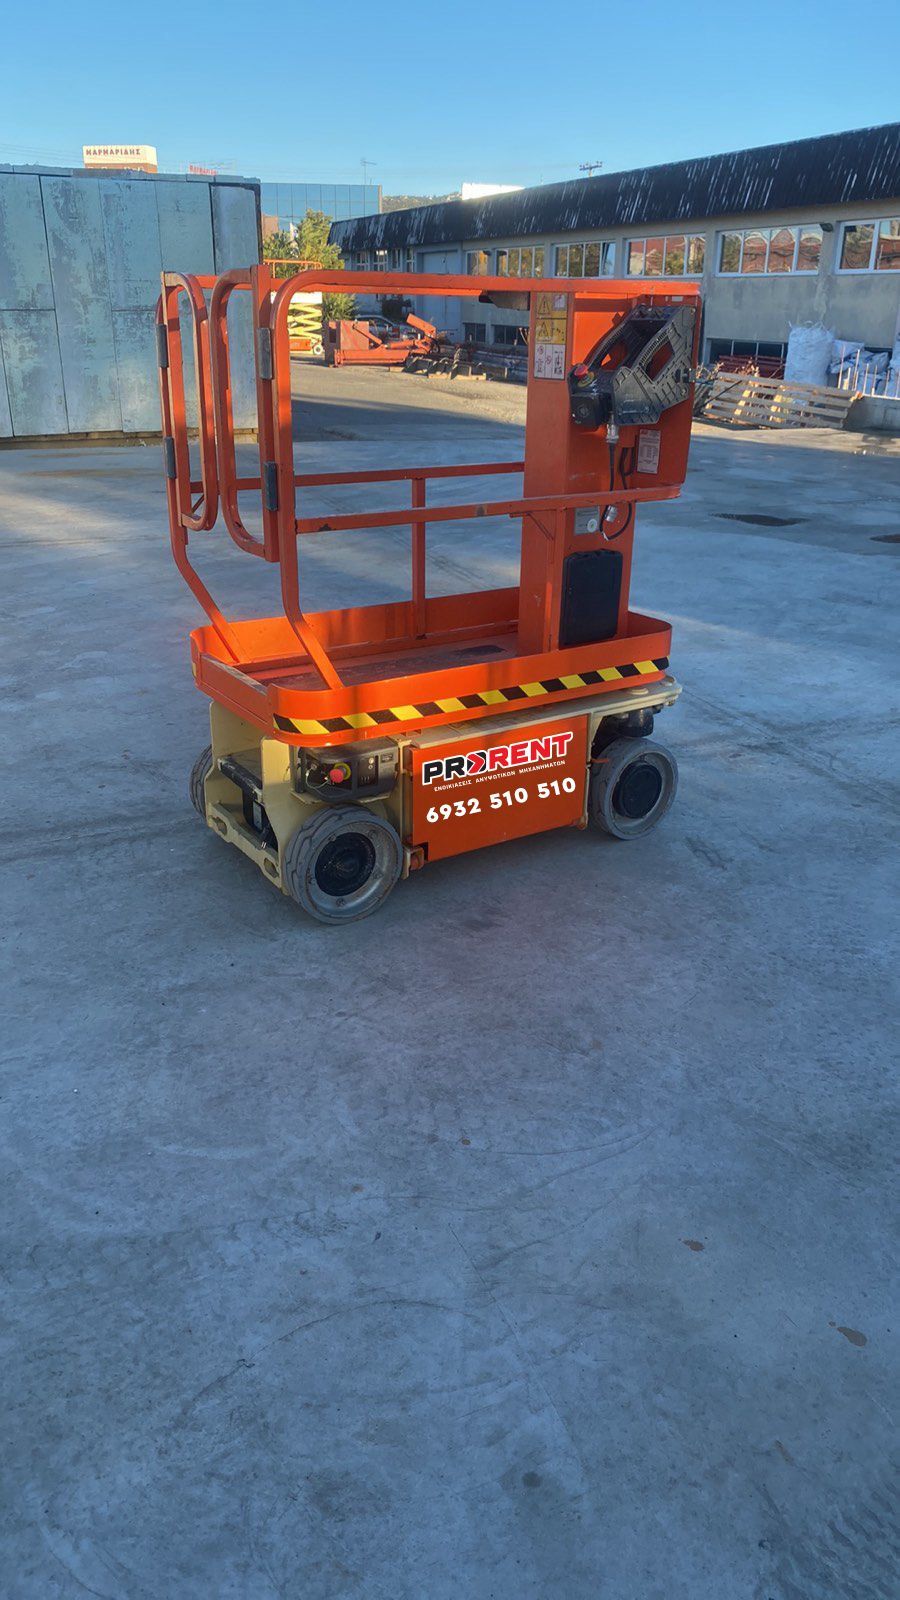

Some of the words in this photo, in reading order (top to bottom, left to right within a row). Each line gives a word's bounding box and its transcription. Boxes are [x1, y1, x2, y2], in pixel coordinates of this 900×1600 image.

[434, 779, 472, 792] ΕΝΟΙΚΙΑΣΕΙΣ
[475, 770, 516, 783] ΑΝΥΨΩΤΙΚΩΝ
[519, 760, 566, 773] ΜΗΧΑΝΗΜΑΤΩΝ
[426, 797, 481, 823] 6932
[489, 787, 529, 809] 510
[537, 777, 576, 799] 510
